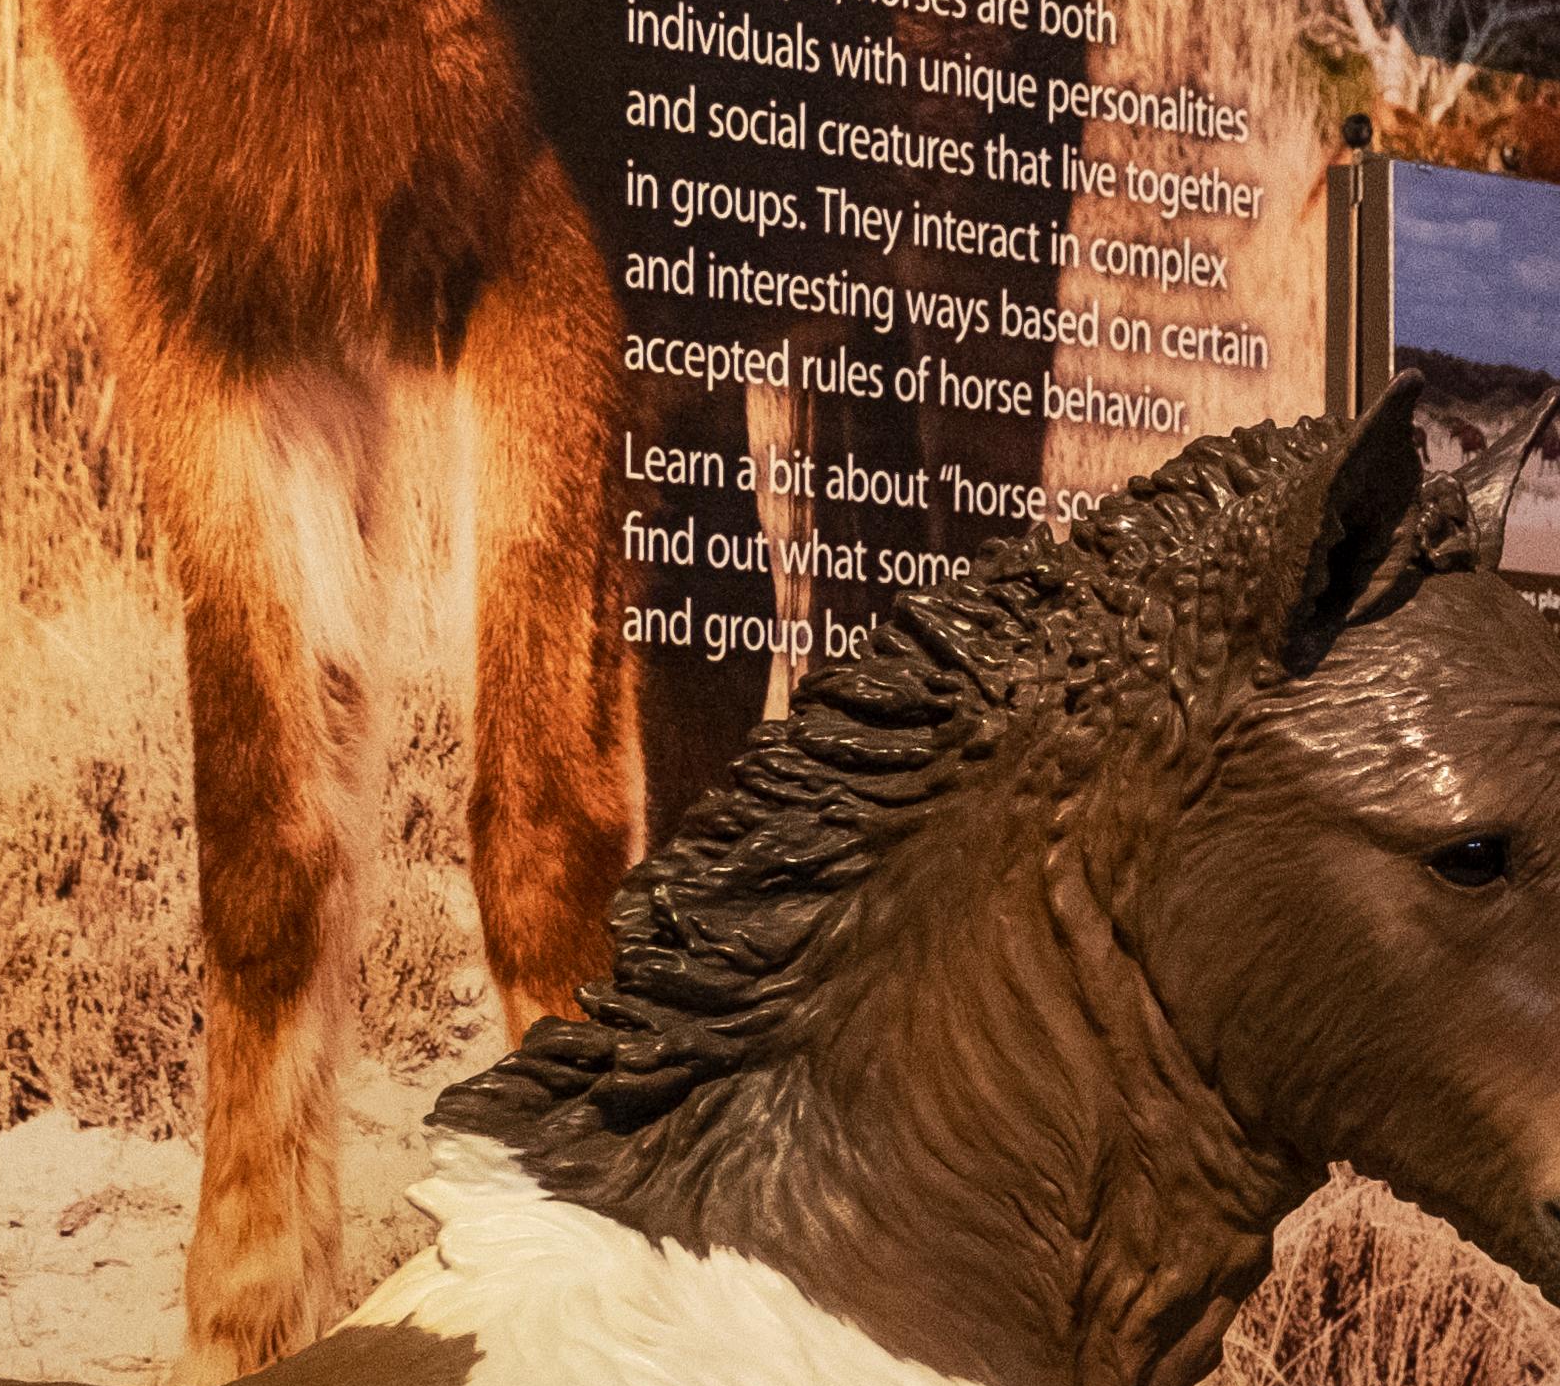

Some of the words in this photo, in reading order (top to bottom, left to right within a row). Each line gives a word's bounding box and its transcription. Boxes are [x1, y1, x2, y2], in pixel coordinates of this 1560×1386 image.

[830, 34, 908, 88] with
[919, 51, 1038, 115] unique
[1047, 77, 1248, 141] personalities
[625, 83, 697, 135] and
[708, 98, 807, 151] social
[817, 118, 976, 177] creatures
[984, 132, 1052, 189] that
[1062, 143, 1117, 199] live
[1126, 160, 1264, 219] together
[626, 158, 659, 210] in
[670, 177, 807, 238] groups.
[815, 185, 903, 257] They
[912, 199, 1041, 265] interact
[1050, 219, 1079, 267] in
[1090, 237, 1228, 292] complex
[624, 244, 695, 297] and
[708, 250, 895, 335] interesting
[905, 289, 991, 344] ways
[1000, 287, 1098, 347] based
[1109, 315, 1151, 354] on
[1161, 323, 1268, 369] certain
[623, 333, 790, 393] accepted
[801, 344, 885, 400] rules
[893, 354, 932, 404] of
[939, 357, 1033, 418] horse
[1044, 370, 1190, 435] behavior.
[624, 430, 725, 489] Learn
[735, 454, 756, 492] a
[768, 444, 816, 500] bit
[825, 451, 930, 510] about
[939, 463, 1052, 528] “horse
[621, 508, 695, 567] find
[706, 531, 770, 574] out
[778, 528, 868, 582] what
[877, 549, 970, 586] some
[622, 595, 693, 647] and
[703, 599, 813, 672] group
